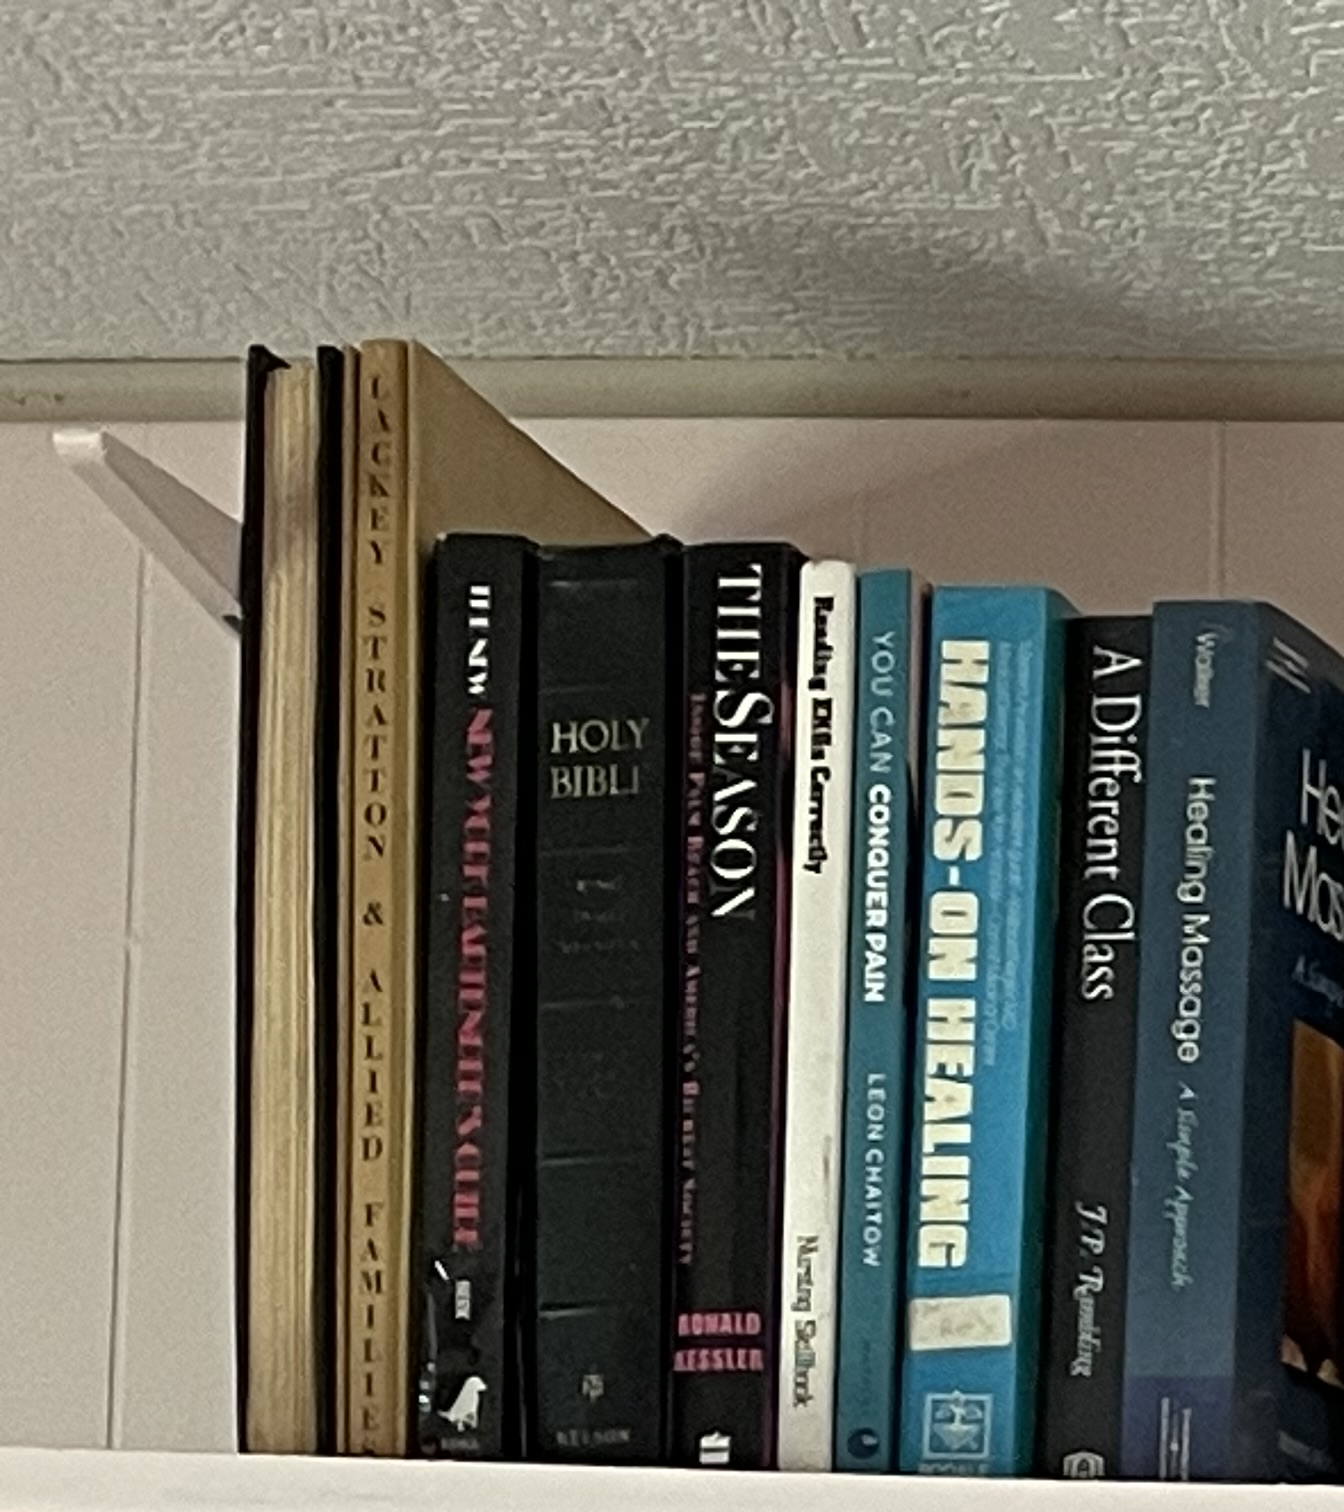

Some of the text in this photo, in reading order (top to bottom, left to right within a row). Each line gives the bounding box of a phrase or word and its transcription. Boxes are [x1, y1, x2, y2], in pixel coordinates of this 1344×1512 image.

[368, 375, 396, 567] LACKEY
[362, 605, 389, 860] STRATION
[466, 638, 491, 696] NEW
[549, 717, 650, 756] HOLY
[806, 596, 835, 691] Reading
[461, 793, 491, 882] YORK
[465, 708, 493, 788] NEW
[709, 563, 776, 921] THE SEASON
[802, 766, 833, 875] Correctly
[861, 630, 898, 1002] YOU CAN CONQUER PAIN
[926, 639, 991, 982] HANDS-ON
[1081, 644, 1144, 1001] A Different Class
[361, 900, 384, 926] &
[360, 968, 384, 1162] ALLIED
[1162, 776, 1217, 1292] Healing Massage A Simple Approach
[861, 1072, 888, 1266] LEON CHAITOW
[916, 997, 976, 1269] HEALING
[791, 1234, 820, 1312] Nursing
